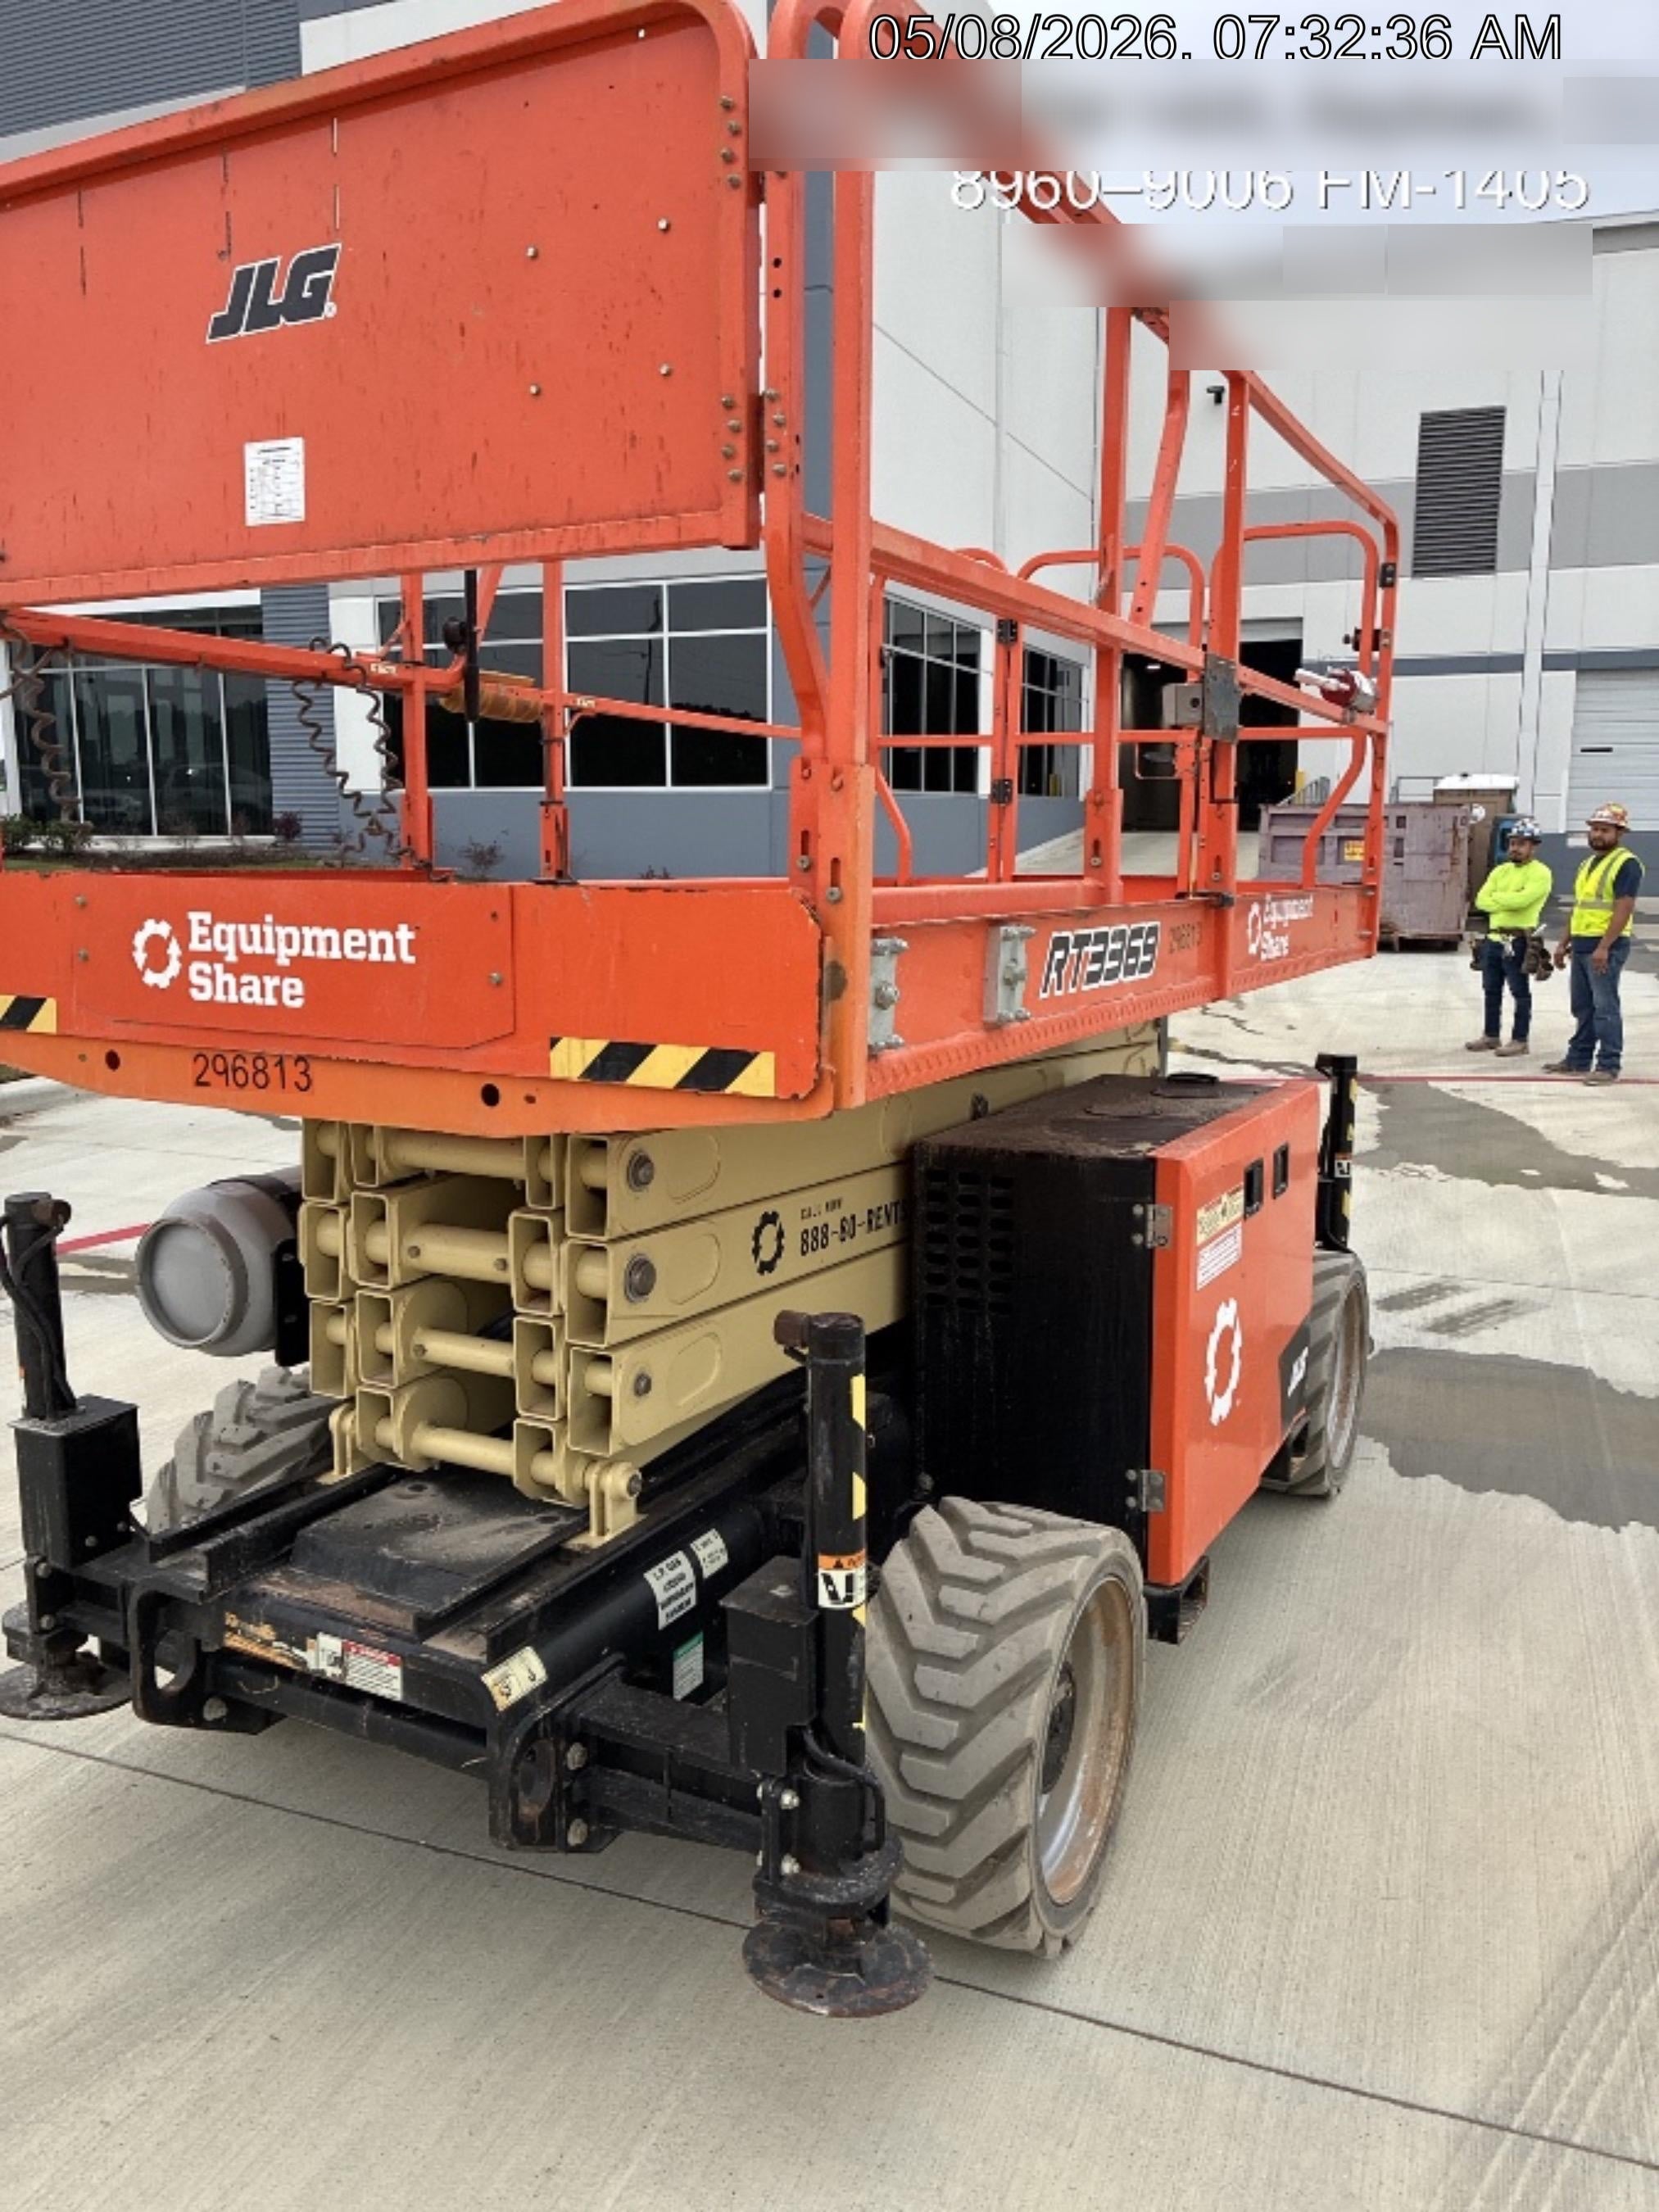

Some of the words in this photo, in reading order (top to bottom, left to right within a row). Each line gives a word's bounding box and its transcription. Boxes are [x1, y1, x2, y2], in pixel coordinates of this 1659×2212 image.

[206, 243, 342, 344] JLG
[187, 911, 416, 967] Equipment
[1039, 921, 1161, 999] RT3369
[188, 961, 306, 1009] Share
[193, 1052, 315, 1093] 296813
